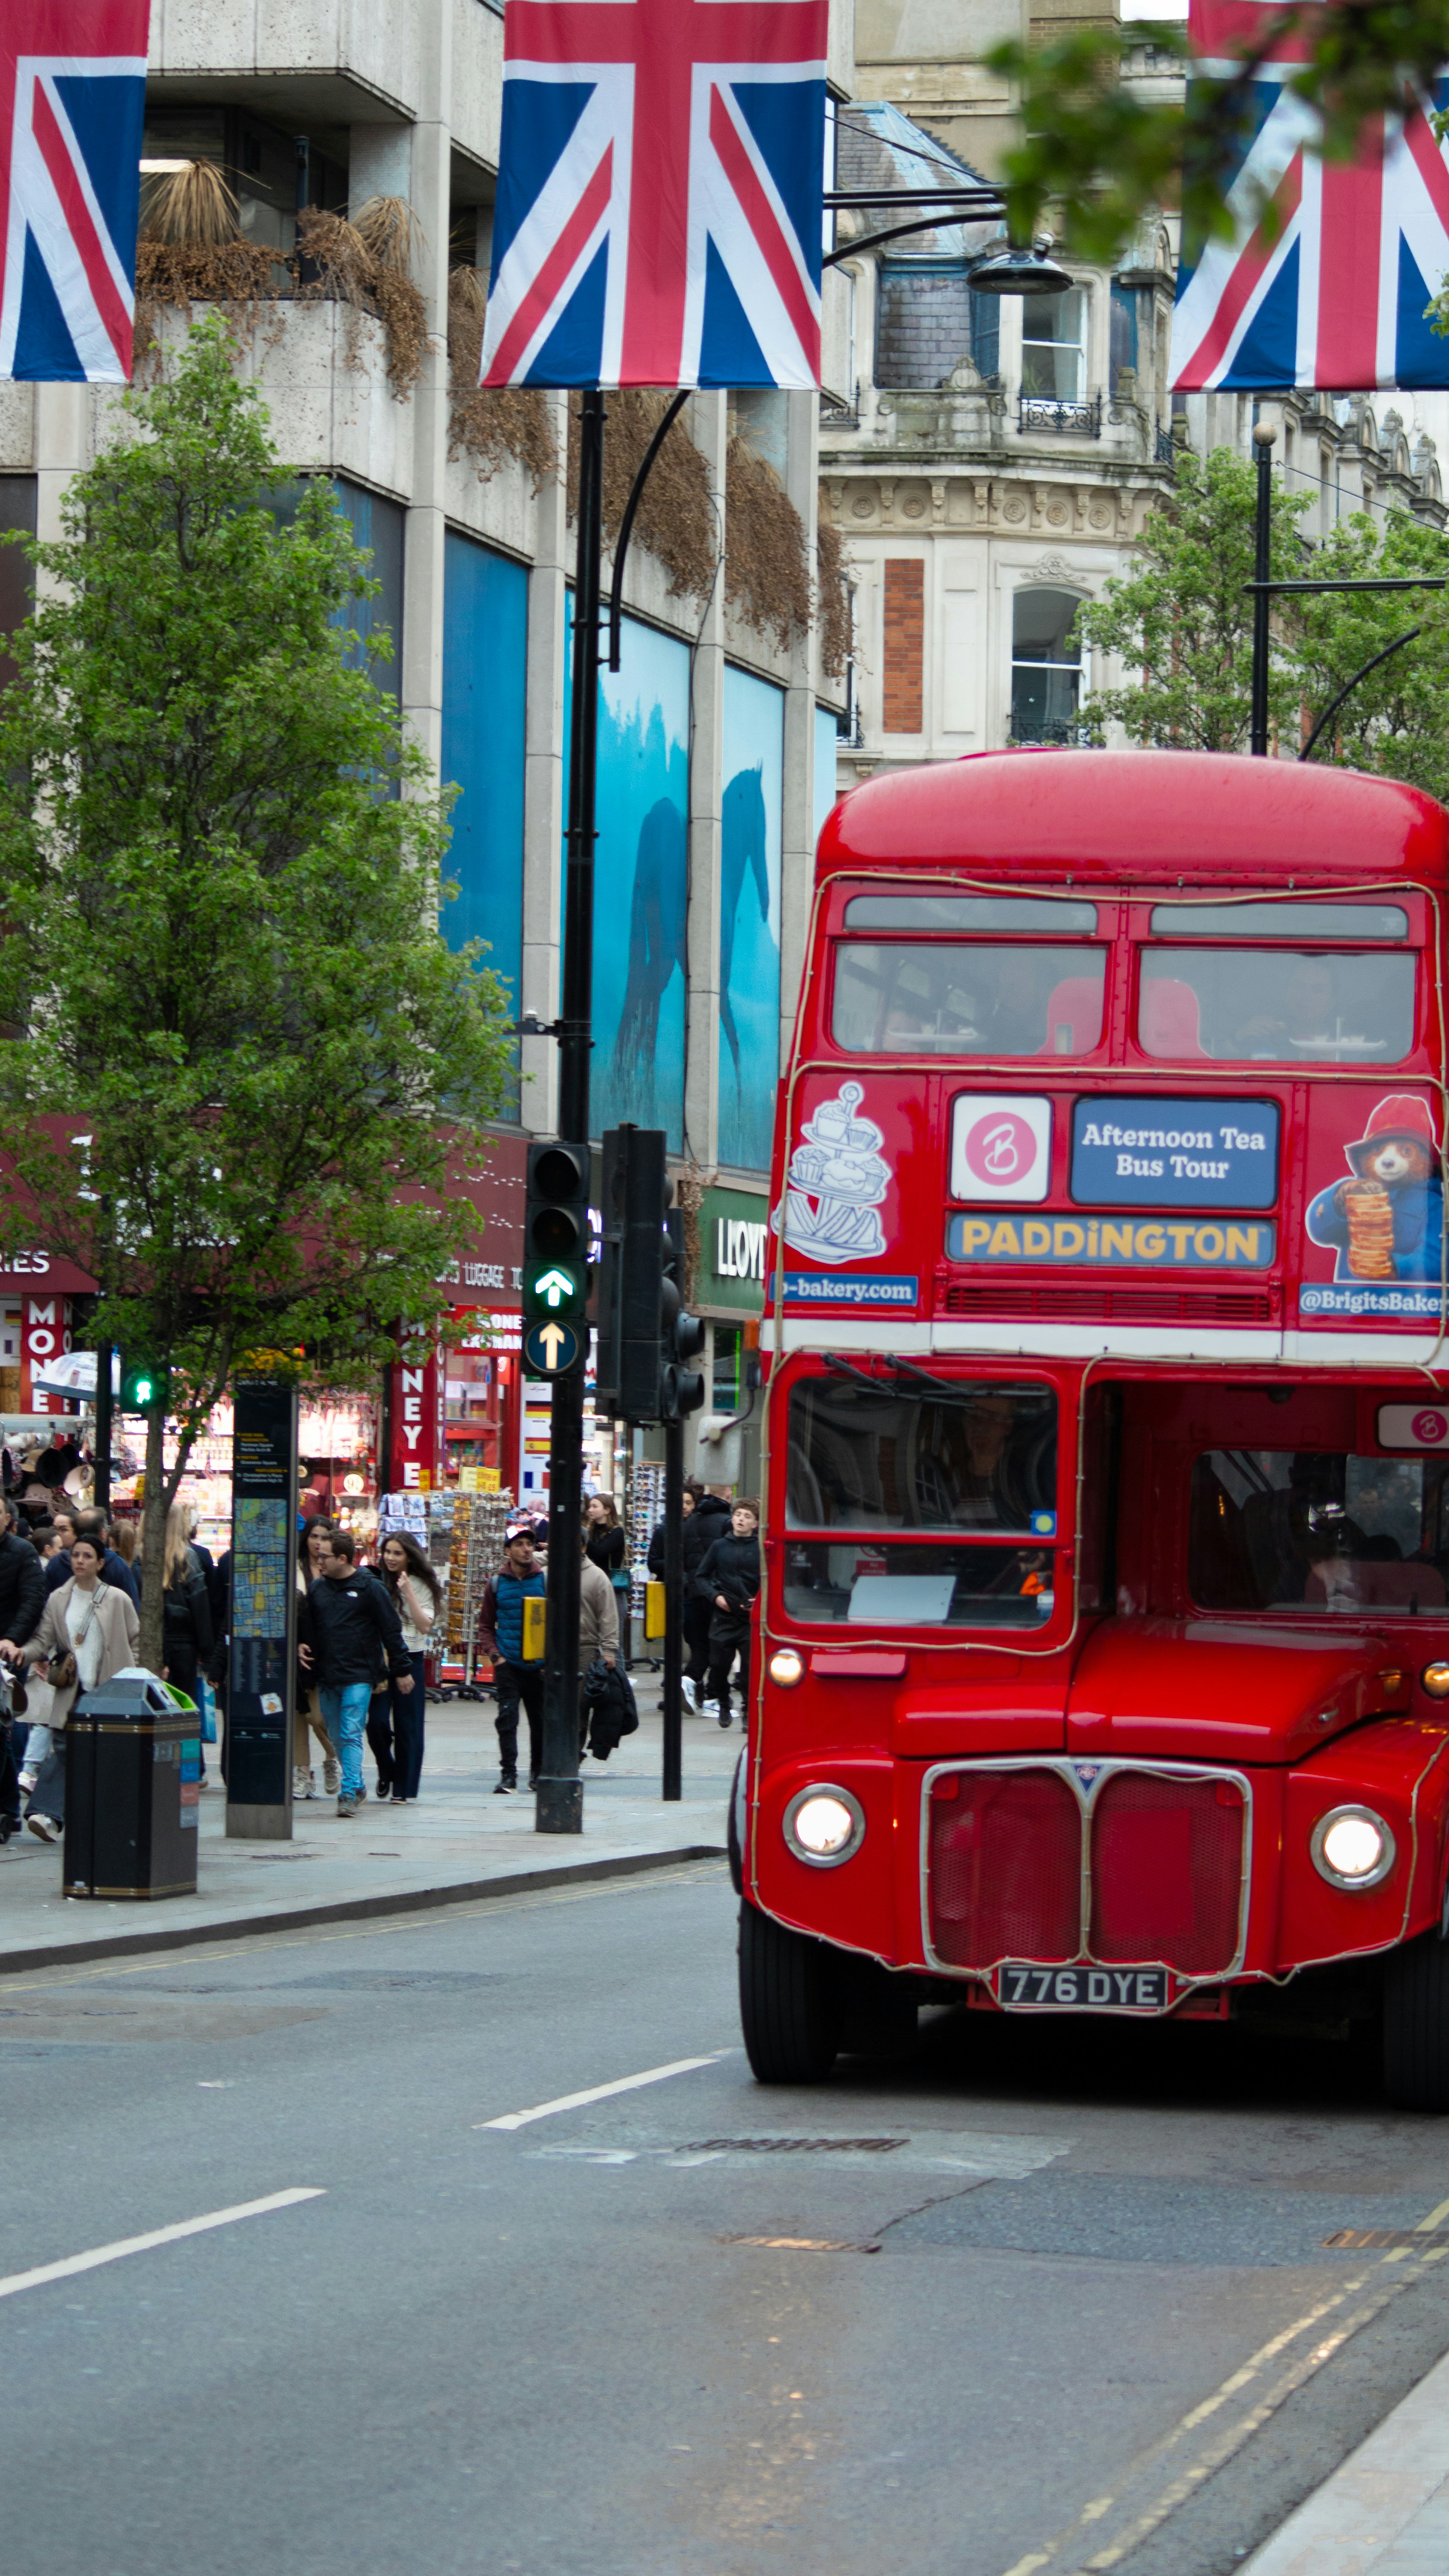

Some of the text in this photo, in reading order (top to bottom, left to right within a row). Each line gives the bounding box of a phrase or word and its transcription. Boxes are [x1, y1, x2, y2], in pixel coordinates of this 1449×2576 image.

[982, 1123, 1018, 1175] B
[1082, 1124, 1266, 1150] Afternoon Tea
[1116, 1154, 1229, 1178] Bus Tour
[462, 1262, 504, 1288] LUGGAGE
[1300, 1291, 1449, 1314] @BrigitsBaker
[1008, 1971, 1158, 2004] 776 DYE
